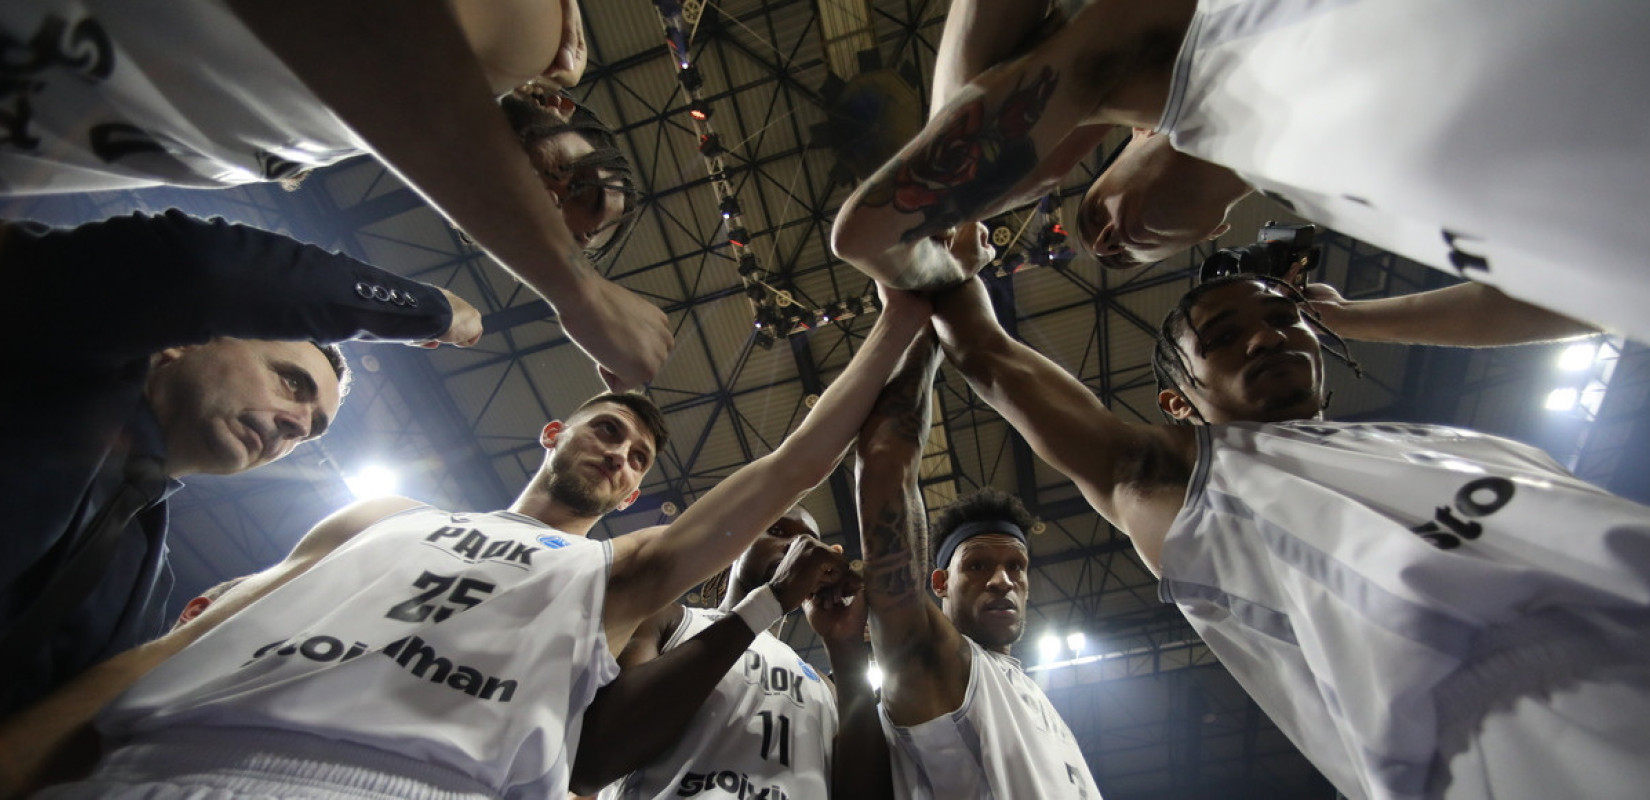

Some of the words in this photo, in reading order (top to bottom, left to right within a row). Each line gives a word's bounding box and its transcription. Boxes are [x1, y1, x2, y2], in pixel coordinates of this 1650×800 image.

[425, 526, 541, 566] PAOK
[384, 570, 497, 624] 25
[756, 710, 789, 767] 11
